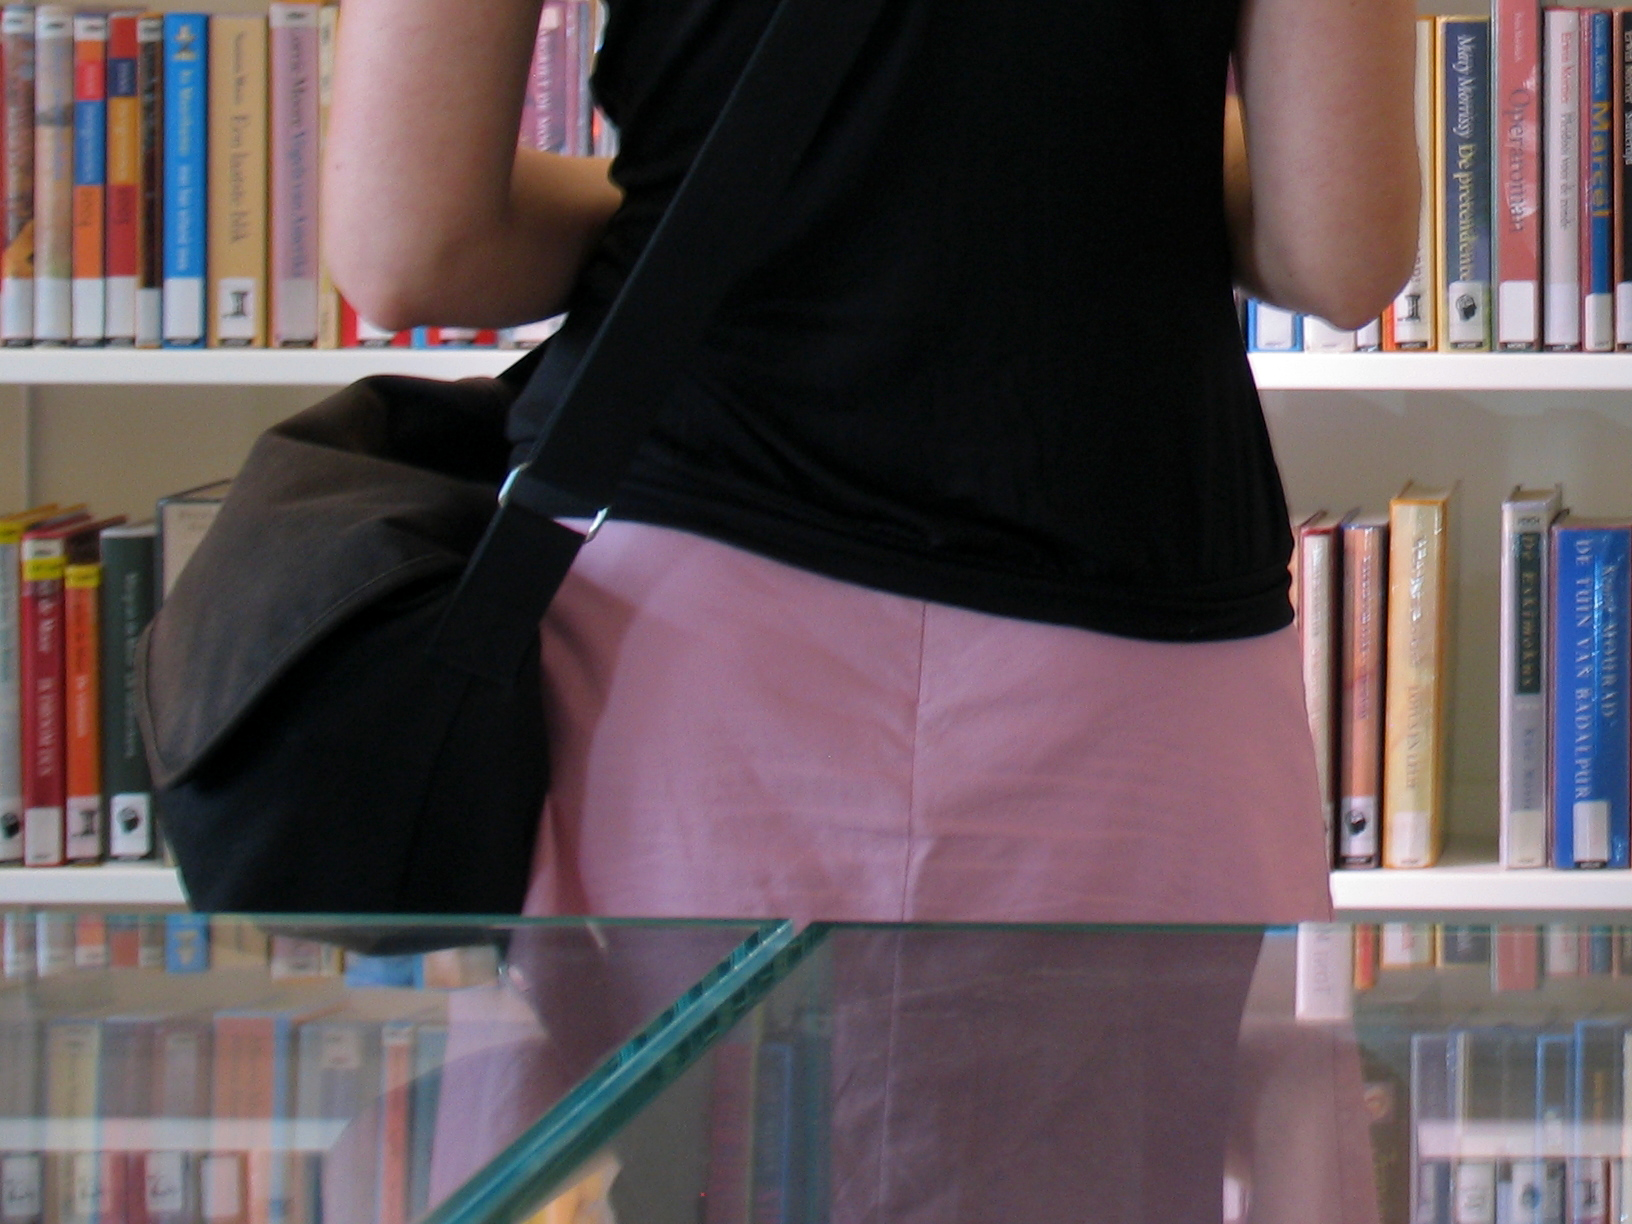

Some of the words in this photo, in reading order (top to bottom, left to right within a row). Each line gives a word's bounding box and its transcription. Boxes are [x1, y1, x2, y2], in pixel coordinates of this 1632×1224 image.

[1453, 35, 1476, 75] Mary
[1454, 77, 1477, 137] Morrissy
[1458, 144, 1478, 169] De
[1502, 88, 1531, 234] Operaroman
[1592, 101, 1613, 218] Marcel
[1575, 539, 1593, 566] DE
[1575, 577, 1594, 627] TUIN
[1575, 637, 1594, 678] VAN
[1574, 688, 1594, 801] BADALPUR
